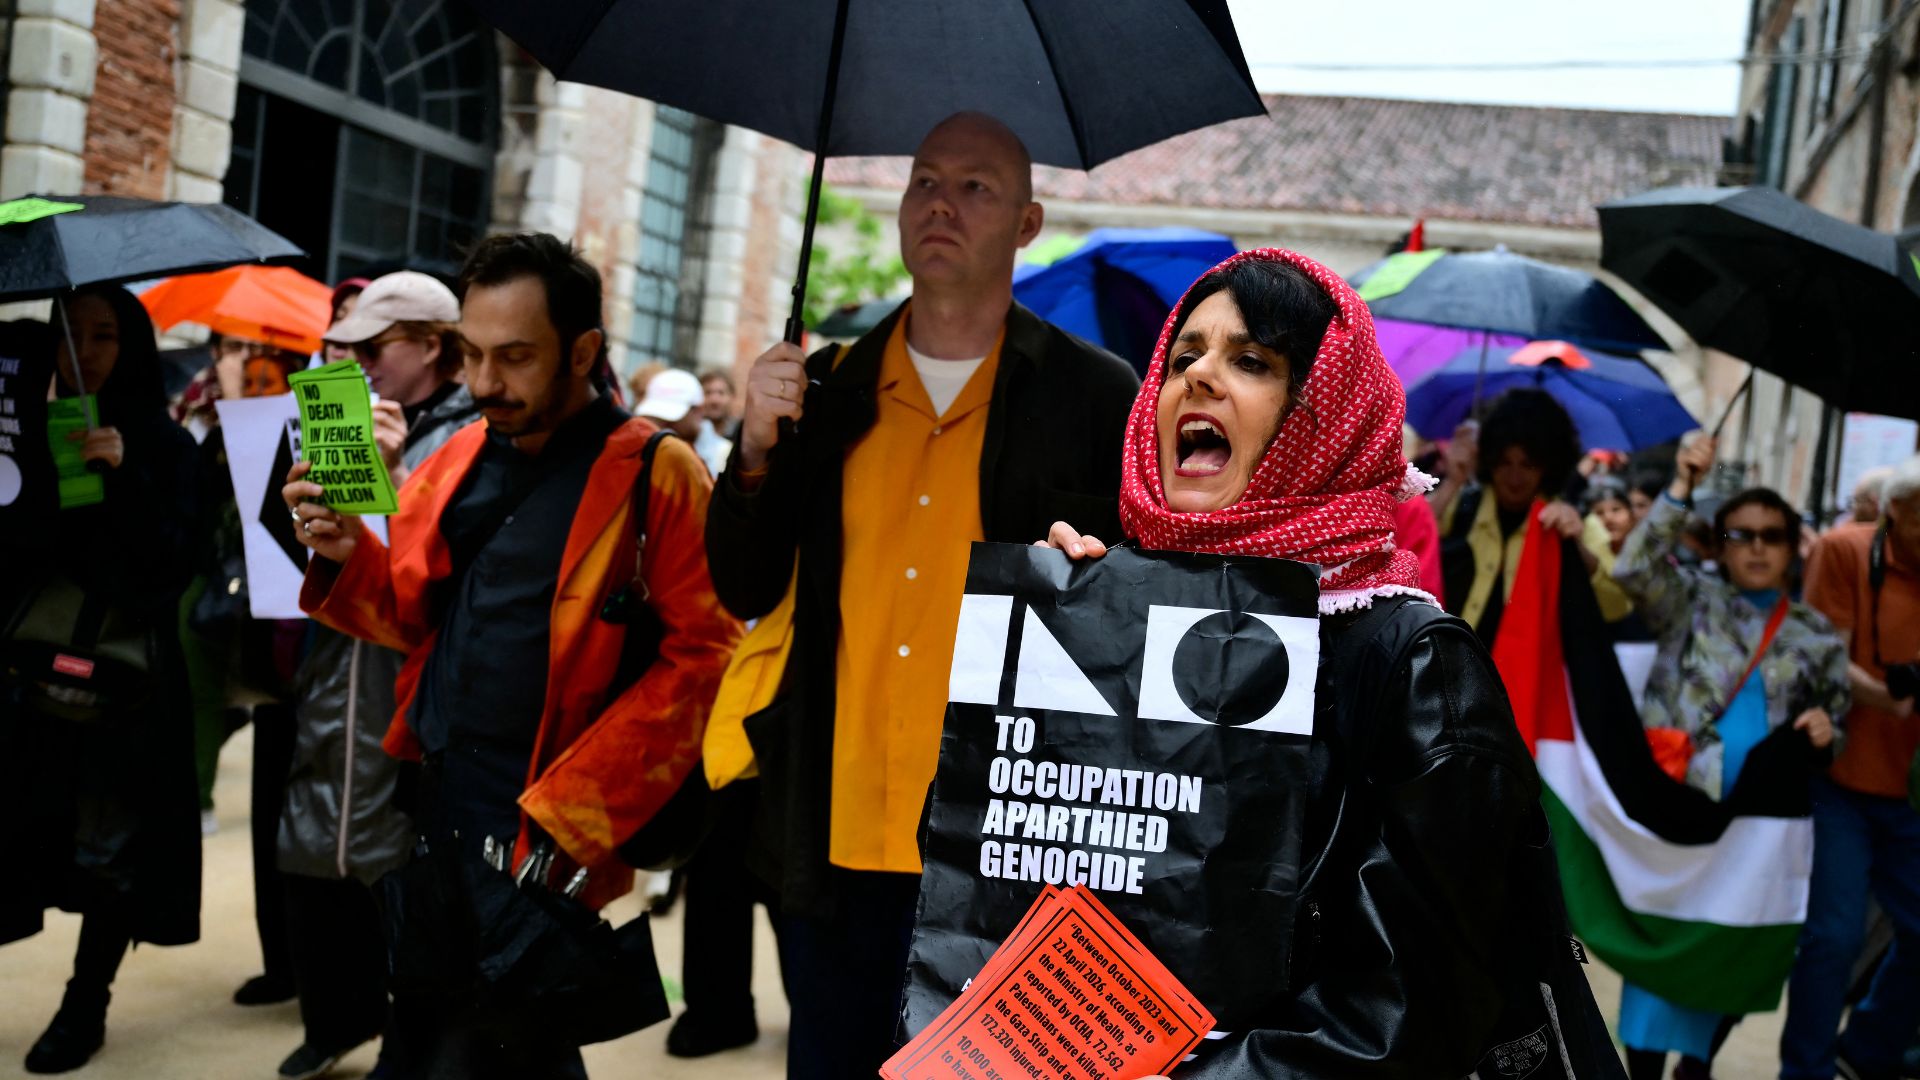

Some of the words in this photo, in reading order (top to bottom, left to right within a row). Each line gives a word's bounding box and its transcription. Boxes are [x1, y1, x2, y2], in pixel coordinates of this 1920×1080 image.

[303, 384, 320, 400] NO
[308, 403, 344, 420] DEATH
[310, 427, 321, 443] IN
[323, 425, 363, 442] VENICE
[309, 450, 321, 465] NO
[325, 449, 339, 465] TO
[342, 449, 371, 464] THE
[995, 716, 1035, 753] TO
[989, 757, 1202, 813] OCCUPATION
[982, 799, 1168, 852] APARTHIED
[980, 841, 1145, 894] GENOCIDE
[1039, 954, 1054, 972] the
[1052, 968, 1088, 1006] Ministry
[1086, 1003, 1100, 1015] of
[1095, 1010, 1124, 1046] Health,
[1125, 1043, 1137, 1056] as
[1052, 937, 1067, 953] 22
[1062, 949, 1087, 973] April
[1082, 968, 1106, 996] 2026,
[1105, 993, 1145, 1035] according
[1143, 1030, 1155, 1043] to
[1107, 964, 1141, 999] October
[1138, 994, 1162, 1019] 2023
[1158, 1016, 1178, 1036] and
[981, 1014, 1014, 1048] 172,320
[995, 999, 1011, 1017] the
[1009, 1013, 1030, 1037] Gaza
[1027, 1033, 1049, 1057] Strip
[1047, 1055, 1068, 1074] and
[1009, 983, 1059, 1036] Palestinians
[1056, 1033, 1078, 1057] were
[1023, 970, 1063, 1008] reported
[1058, 1002, 1072, 1019] by
[1069, 1014, 1094, 1044] OCHA,
[1093, 1038, 1124, 1072] 72,562
[942, 1051, 953, 1063] to
[958, 1036, 990, 1069] 10,000
[1496, 1057, 1511, 1070] AND
[1531, 1042, 1547, 1055] THIS
[1521, 1034, 1541, 1048] DOWN
[1515, 1059, 1532, 1071] OVER
